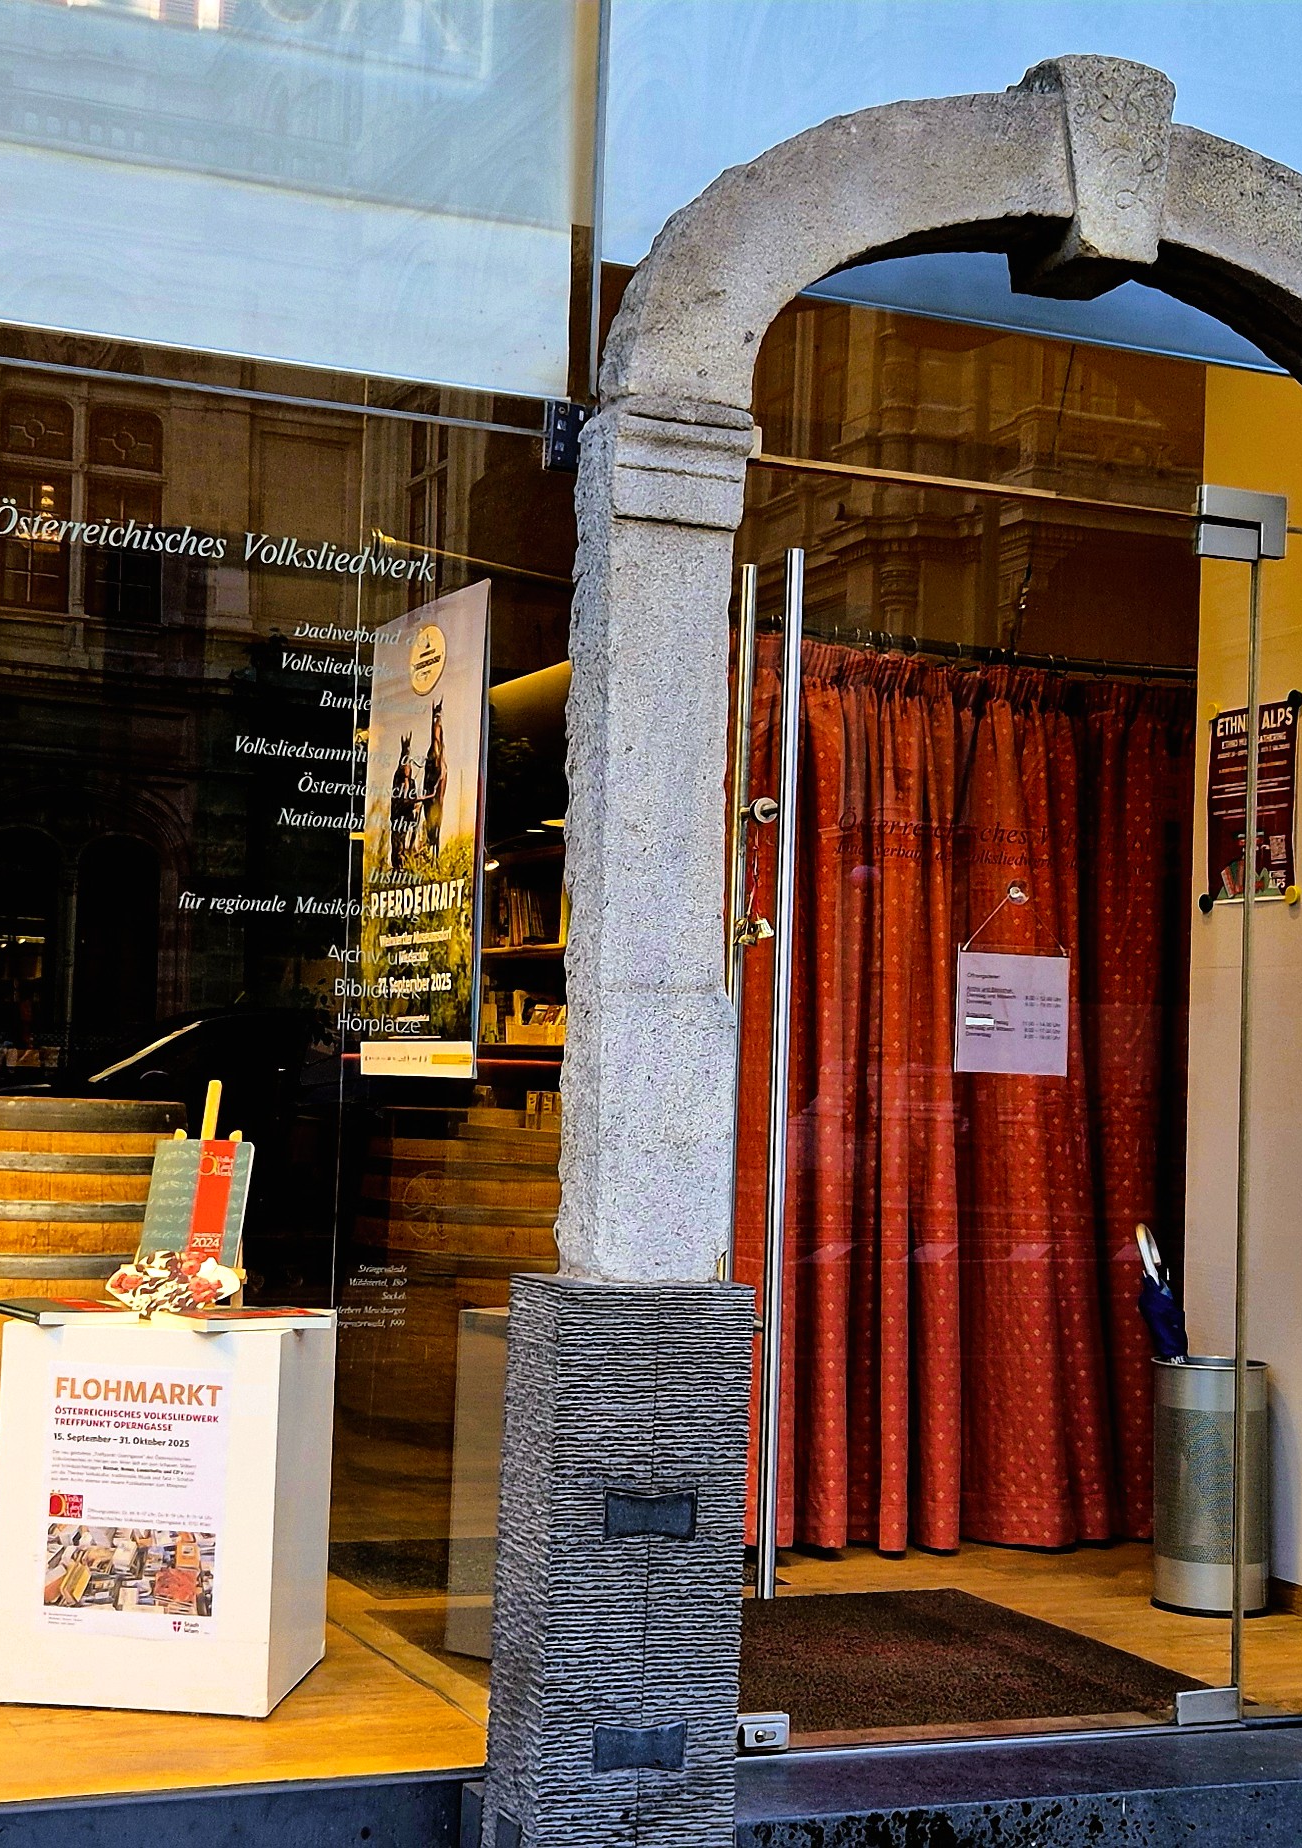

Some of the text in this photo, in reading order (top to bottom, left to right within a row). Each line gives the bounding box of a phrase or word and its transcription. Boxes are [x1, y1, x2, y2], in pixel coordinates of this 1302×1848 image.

[244, 530, 436, 583] Volksliedwerk
[294, 622, 401, 645] Dachverband
[1216, 706, 1294, 737] ETHN ALPS
[178, 891, 205, 909] für
[209, 894, 286, 914] regionale
[371, 879, 465, 919] PFERDEKRAFT
[328, 944, 380, 964] Archiv
[430, 972, 452, 991] 2025
[337, 1012, 421, 1036] Hörplätze
[191, 1237, 221, 1248] 2024
[55, 1377, 223, 1406] FLOHMARKT
[54, 1418, 173, 1432] TREFFPUNKT OPERNGASSE
[55, 1405, 219, 1423] ÖSTERREICHISCHES VOLKSLIEDWERK
[53, 1432, 65, 1441] 15.
[67, 1433, 112, 1443] September
[133, 1437, 166, 1447] Oktober
[168, 1439, 190, 1448] 2025
